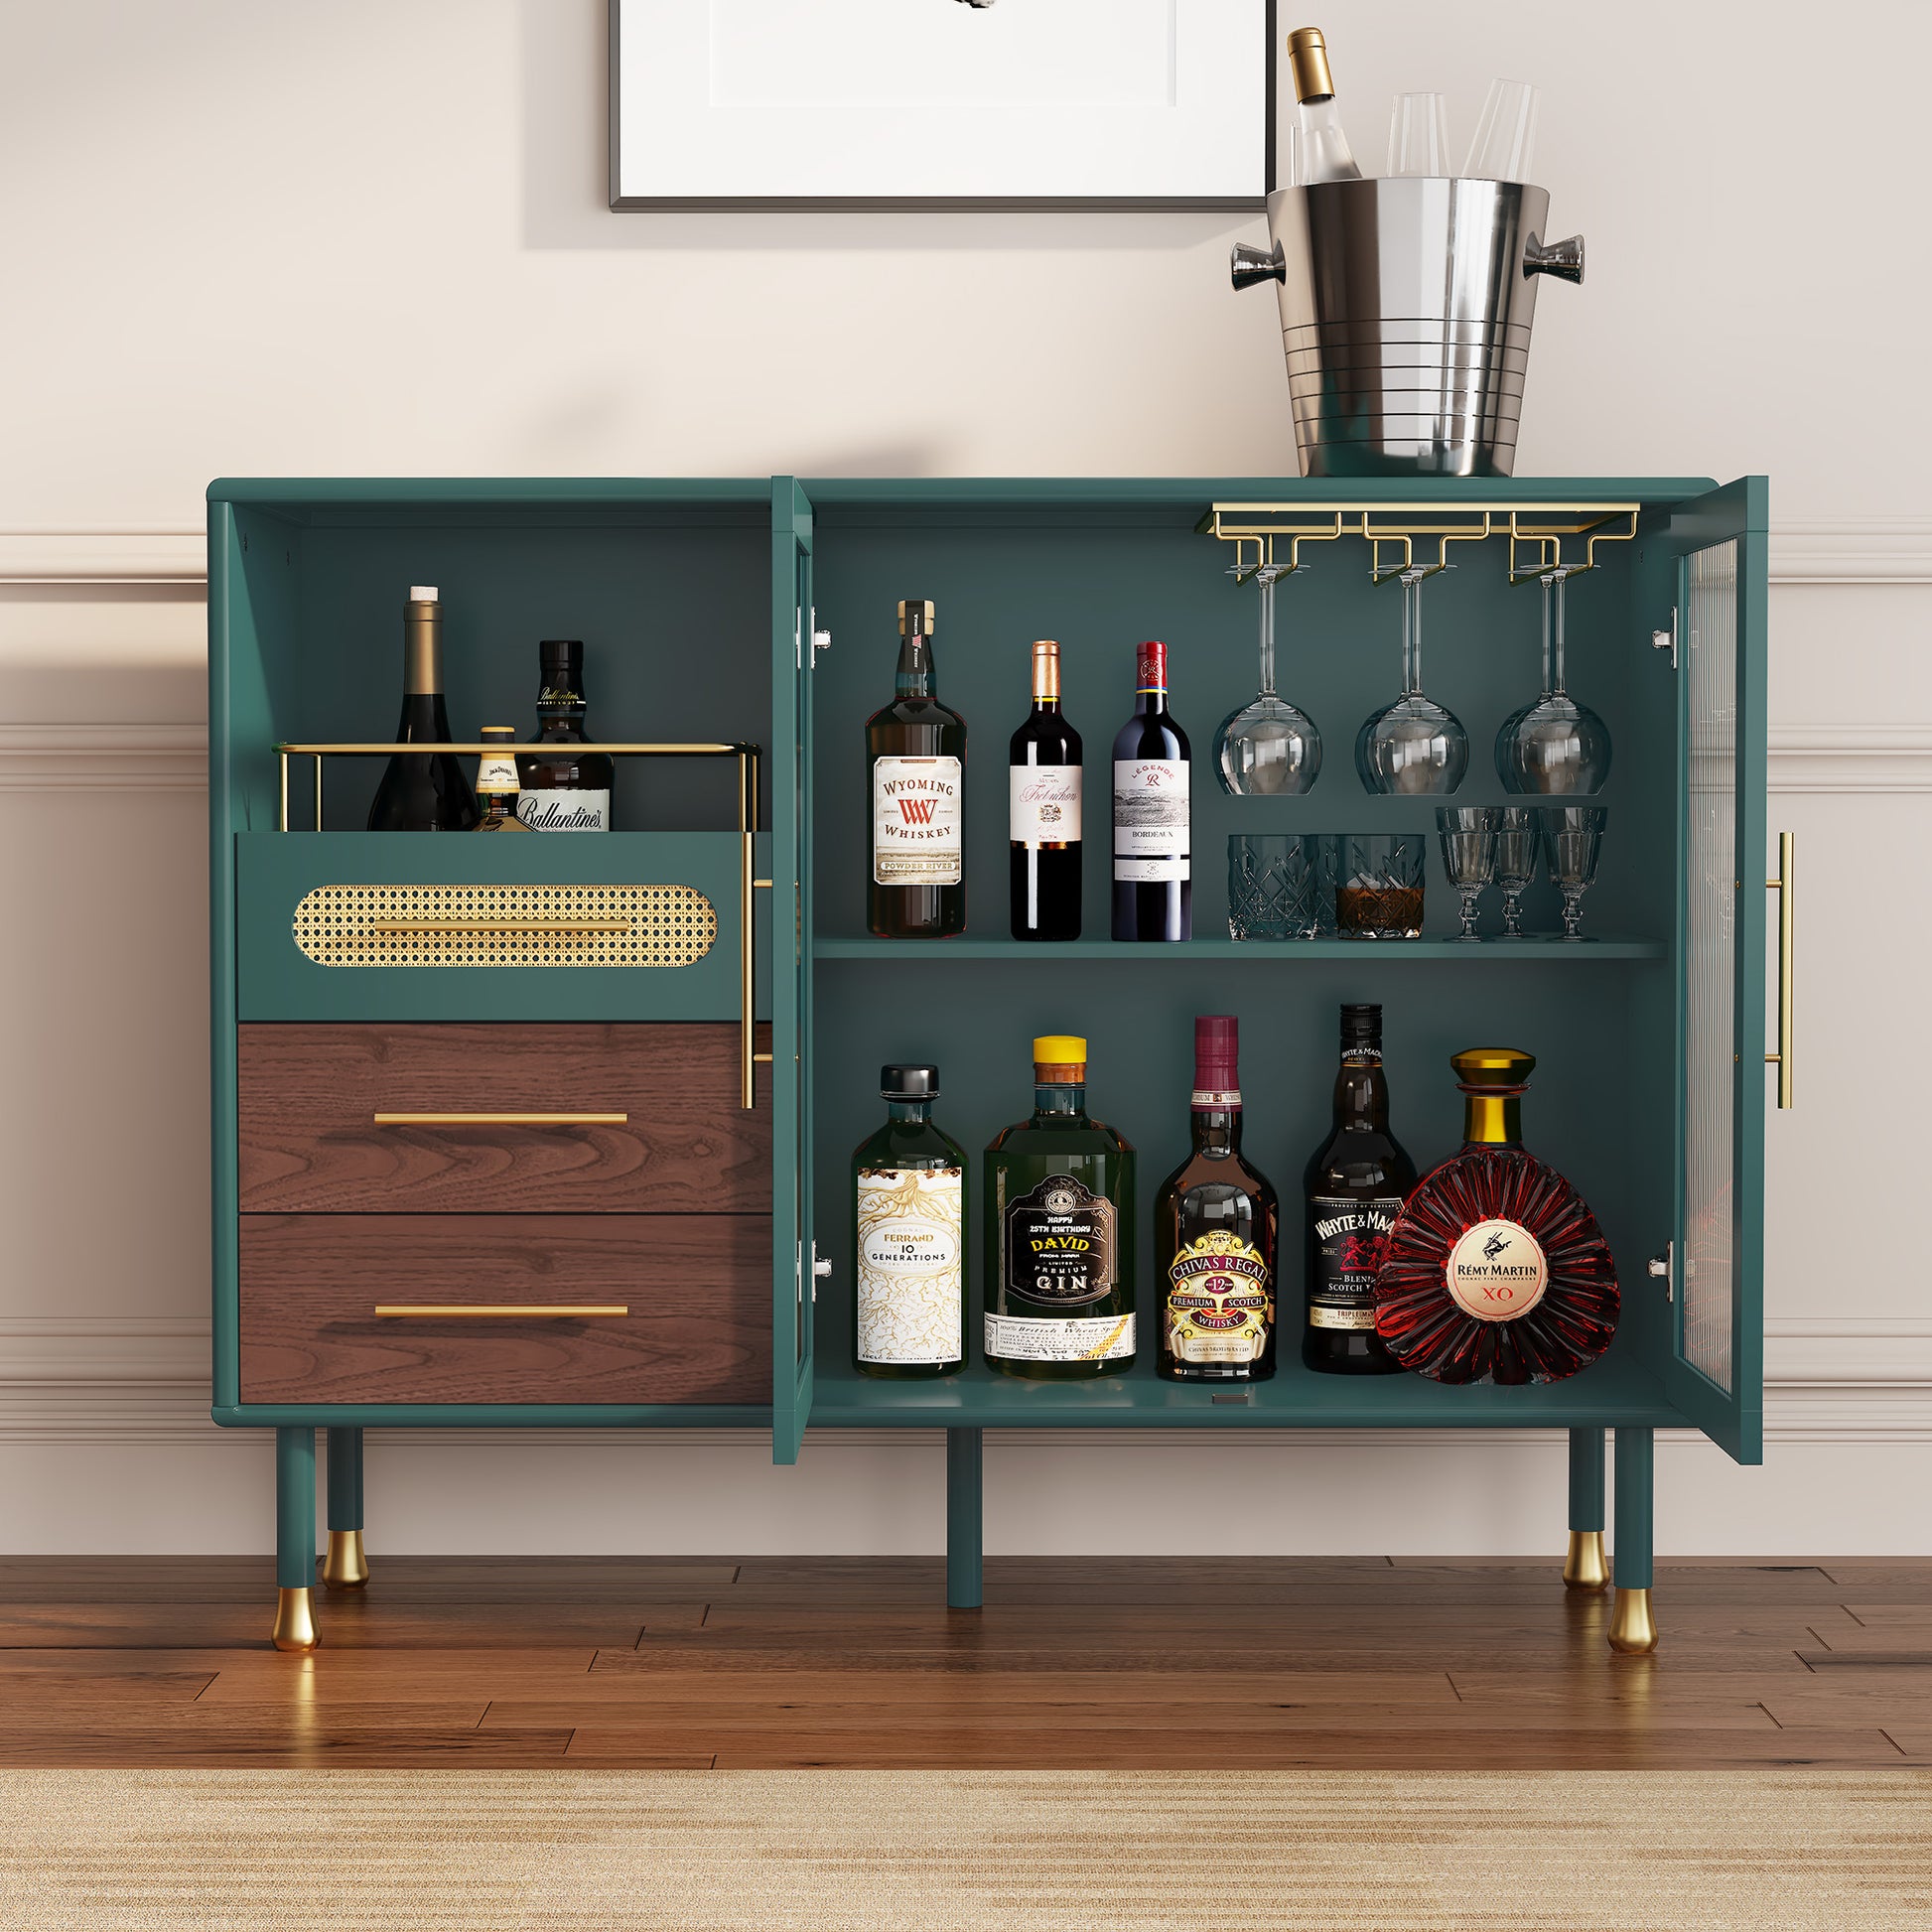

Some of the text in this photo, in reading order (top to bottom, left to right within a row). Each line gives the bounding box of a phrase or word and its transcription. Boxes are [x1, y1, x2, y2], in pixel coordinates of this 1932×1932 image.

[883, 779, 954, 796] WYOMING
[518, 797, 602, 828] Ballantine's
[885, 824, 951, 839] WHISKEY
[1315, 1214, 1358, 1241] WHYTE
[1357, 1214, 1366, 1227] &
[901, 1244, 914, 1254] 10
[1031, 1235, 1090, 1252] DAVID
[1034, 1265, 1088, 1274] PREMIUM
[1173, 1257, 1265, 1282] CHIVAS REGAL
[1457, 1264, 1537, 1276] RÉMY MARTIN
[1036, 1275, 1088, 1290] GIN
[1212, 1278, 1226, 1291] 12
[1327, 1283, 1362, 1292] SCOTCH
[1173, 1297, 1262, 1307] PREMIUM SCOTCH
[1481, 1287, 1514, 1302] XO
[1198, 1315, 1240, 1328] WHISKY
